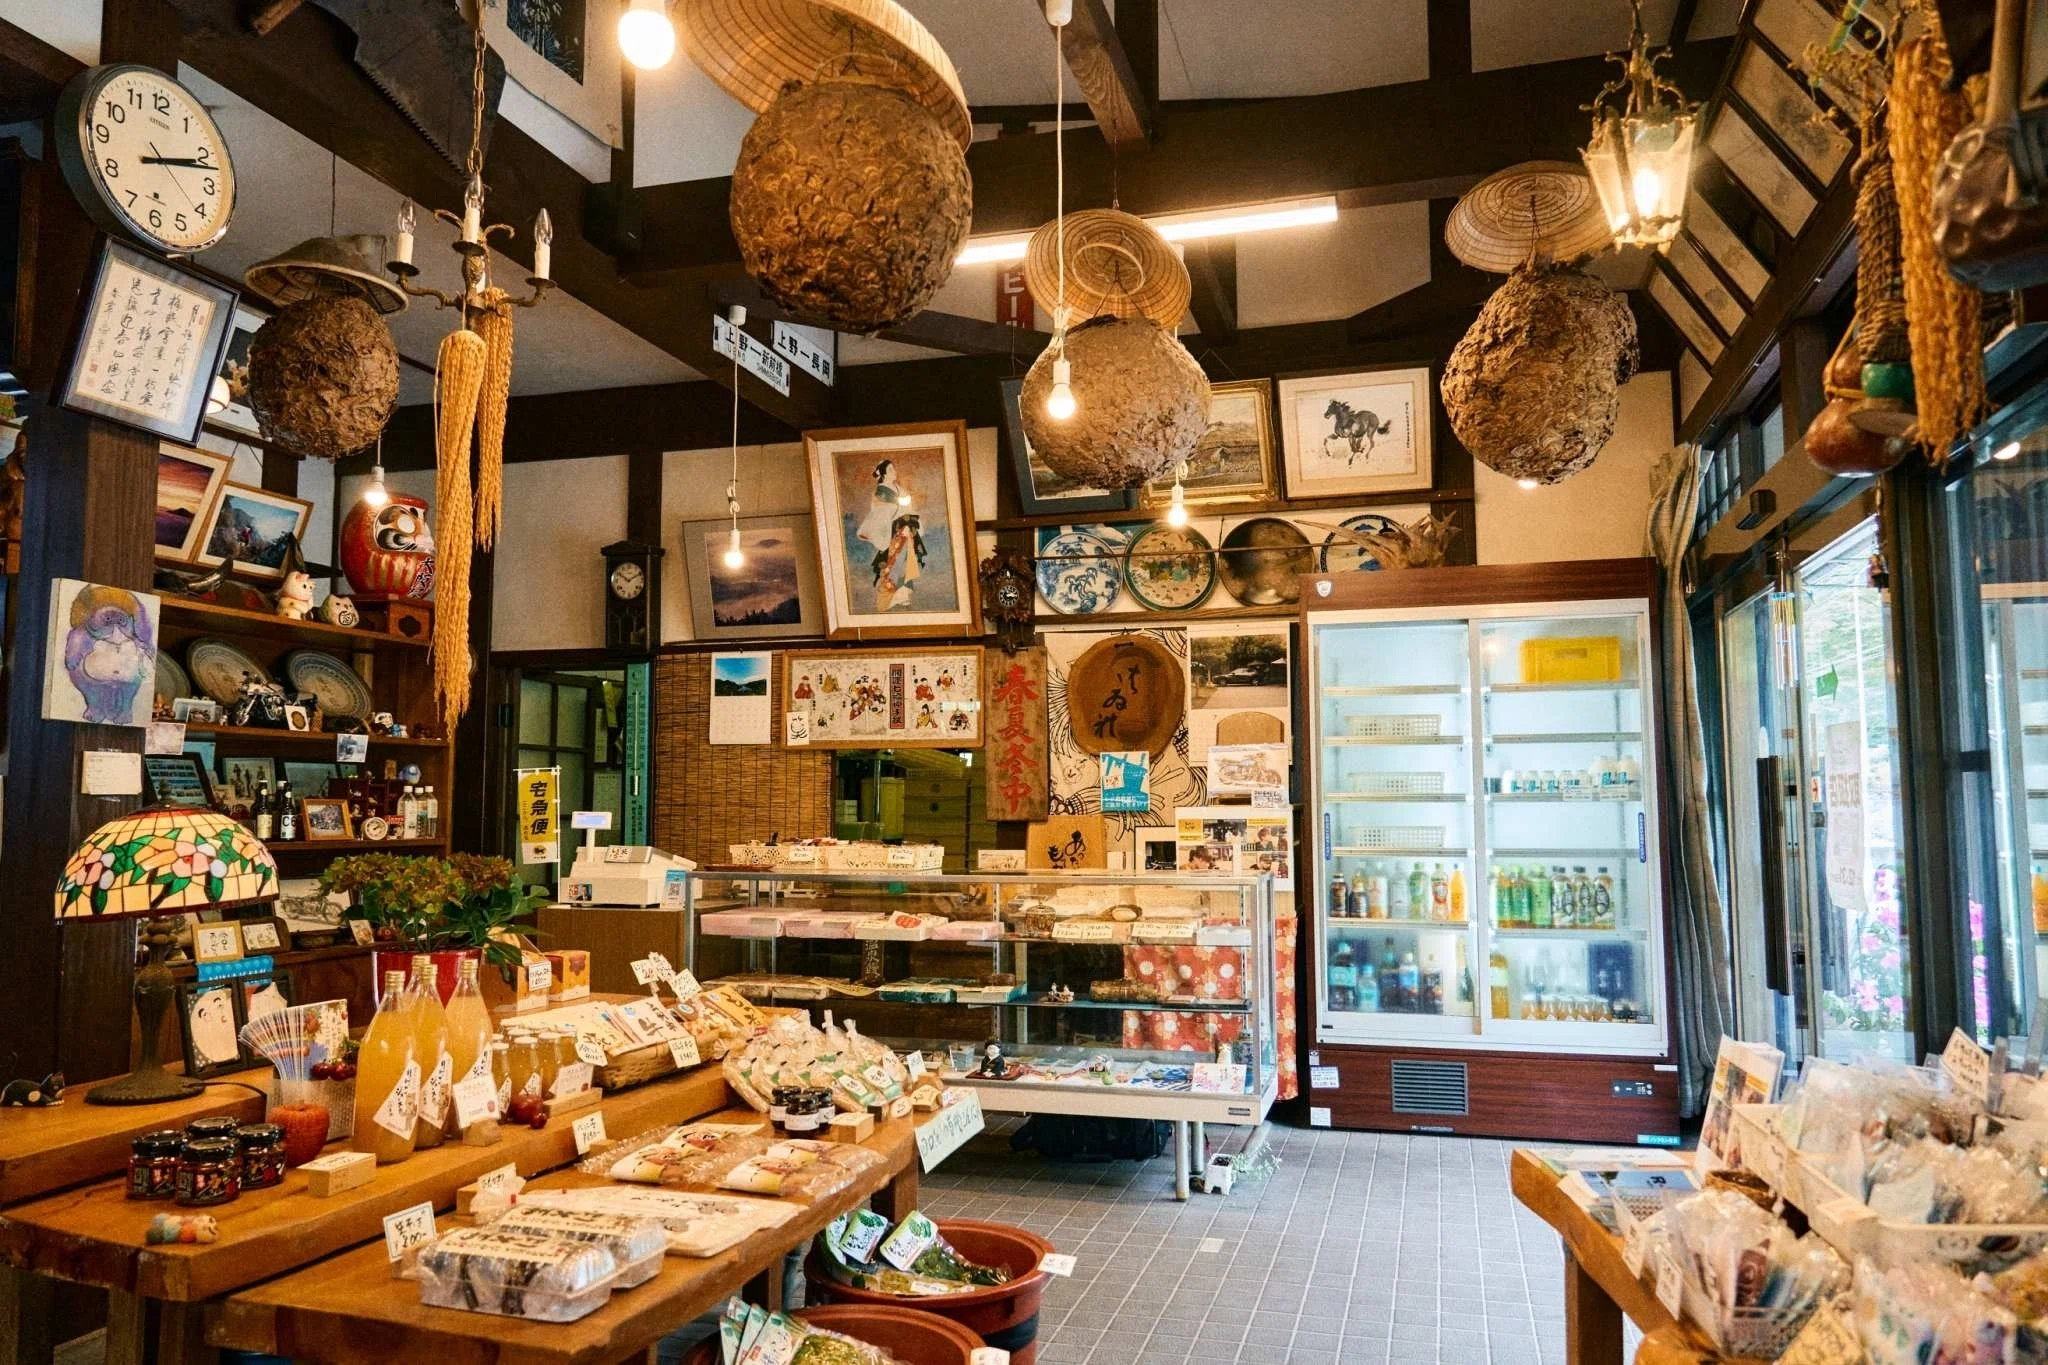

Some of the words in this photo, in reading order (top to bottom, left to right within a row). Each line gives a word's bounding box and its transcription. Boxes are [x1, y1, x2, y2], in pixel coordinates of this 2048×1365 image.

[127, 88, 143, 110] 11
[152, 93, 170, 116] 12
[105, 101, 126, 124] 10
[96, 123, 110, 144] 9
[183, 116, 189, 134] 1
[197, 147, 209, 166] 2
[105, 158, 119, 178] 8
[203, 177, 215, 196] 3
[125, 189, 138, 208] 7
[149, 209, 162, 228] 6
[194, 202, 207, 219] 4
[174, 213, 187, 232] 5
[992, 663, 1040, 814] 春夏冬中
[529, 780, 549, 836] 宅急便
